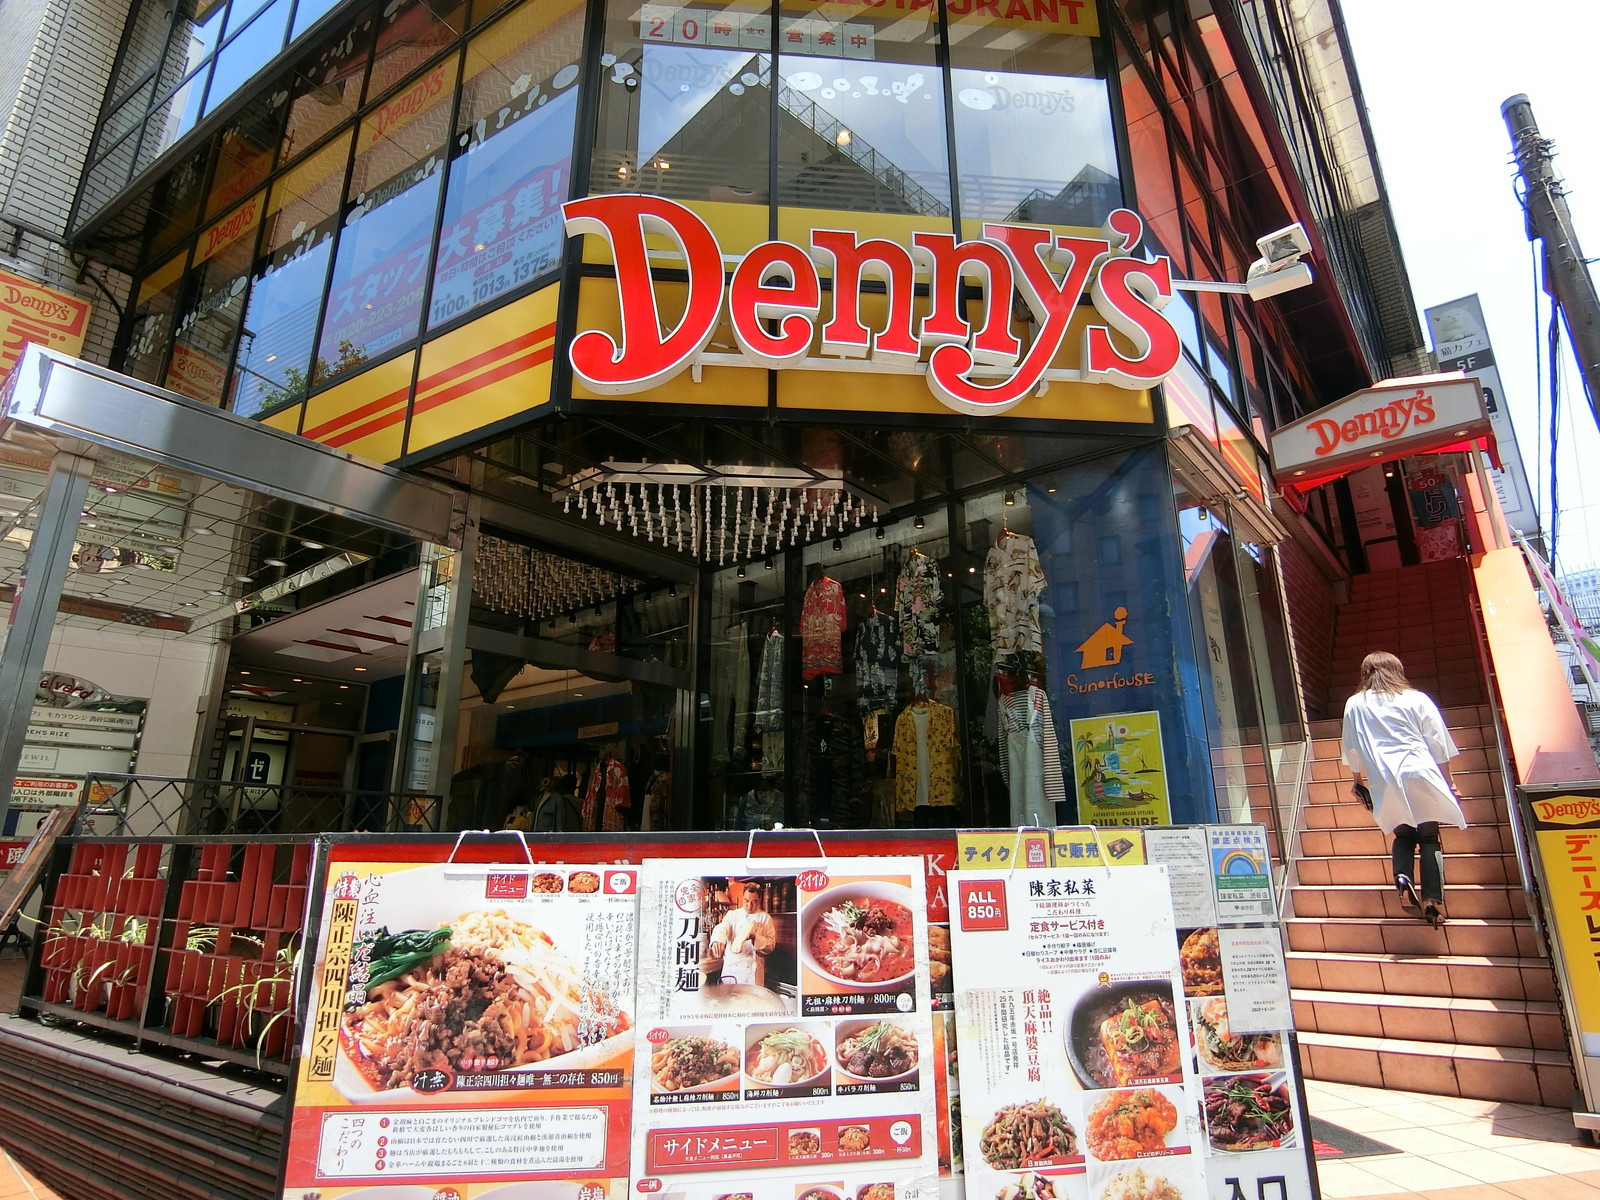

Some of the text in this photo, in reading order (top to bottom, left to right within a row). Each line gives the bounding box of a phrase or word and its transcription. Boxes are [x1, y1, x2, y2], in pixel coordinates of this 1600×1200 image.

[371, 63, 445, 142] Denny's
[993, 86, 1075, 115] Denny's
[204, 199, 257, 258] Denny's
[4, 285, 70, 321] Denny's
[561, 193, 1182, 416] Denny's
[1457, 357, 1477, 371] 5F
[1306, 389, 1436, 456] Denny's
[1538, 799, 1600, 820] Denny's
[965, 846, 1010, 862] テイク
[491, 886, 525, 894] メニュー
[968, 891, 996, 903] ALL
[1029, 878, 1096, 898] 陳家私菜
[968, 906, 1002, 919] 850円
[1030, 919, 1105, 932] 定食サービス付き
[675, 917, 701, 993] 刀削麺
[312, 903, 354, 1077] 陳正宗四川担々麺
[873, 993, 896, 1004] 800円
[1022, 989, 1041, 1083] 頂天麻婆豆腐
[591, 1072, 618, 1084] 850円
[336, 1118, 350, 1172] こだわり
[350, 1118, 365, 1149] 四つの
[663, 1136, 768, 1156] サイドメニュー
